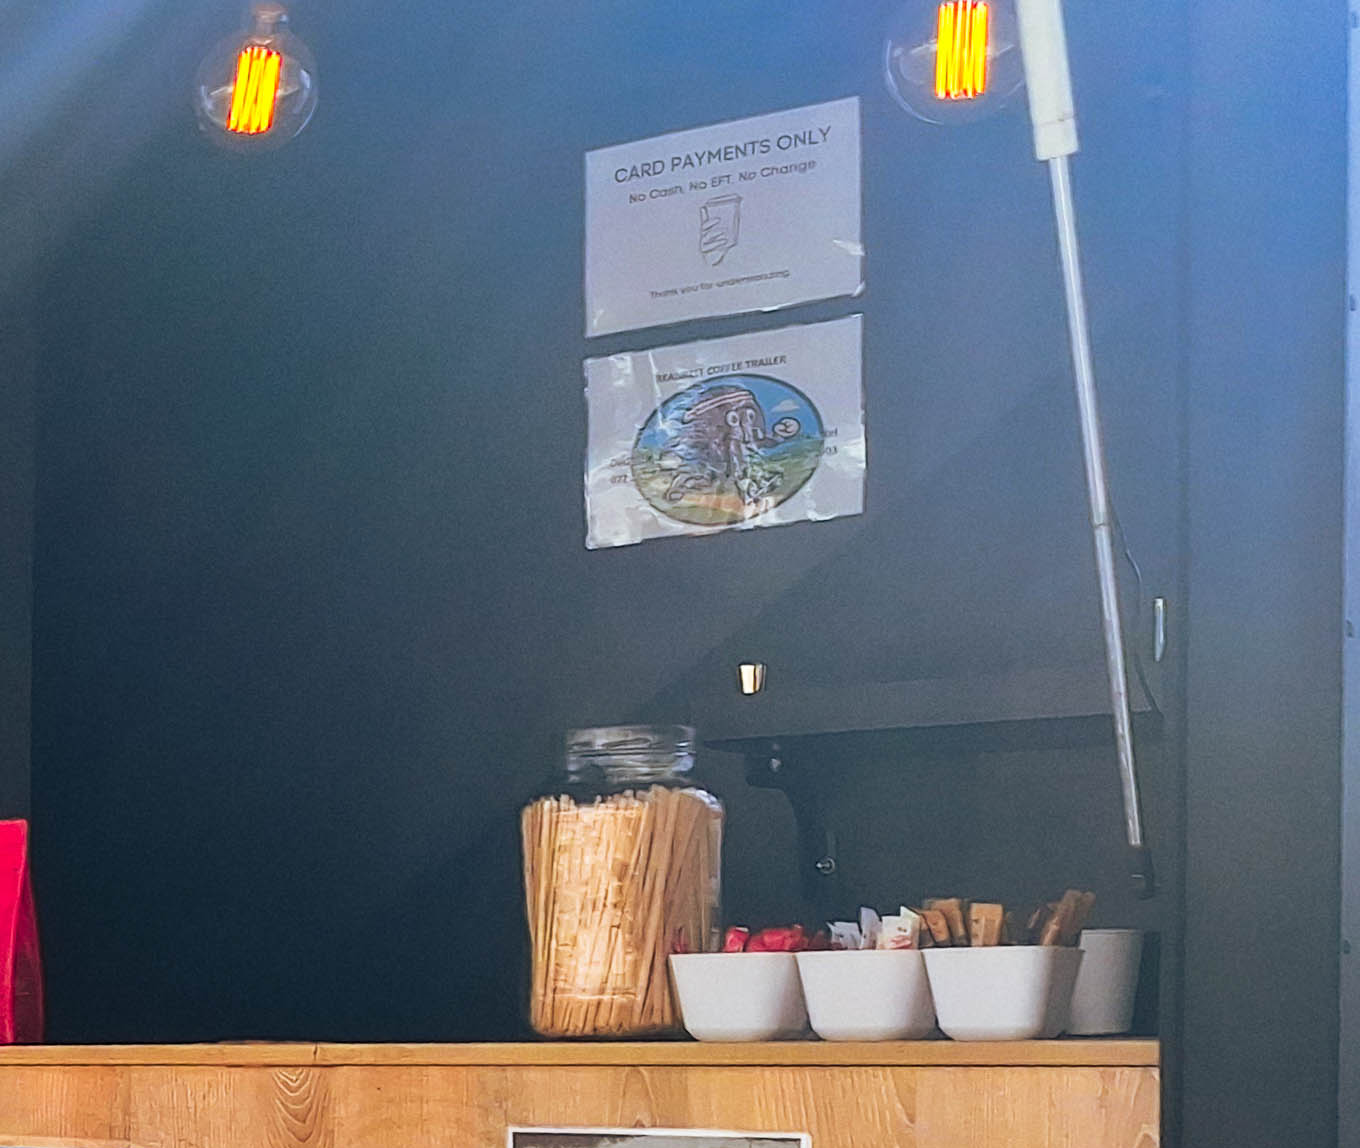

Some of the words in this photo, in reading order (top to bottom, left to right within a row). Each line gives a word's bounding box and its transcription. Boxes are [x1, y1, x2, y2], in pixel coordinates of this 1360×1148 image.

[614, 159, 665, 184] CARD
[671, 138, 771, 172] PAYMENTS
[776, 126, 832, 152] ONLY
[629, 193, 647, 204] No
[689, 180, 707, 192] No
[738, 170, 757, 182] No
[760, 160, 817, 178] Change
[745, 355, 787, 369] TRAILER
